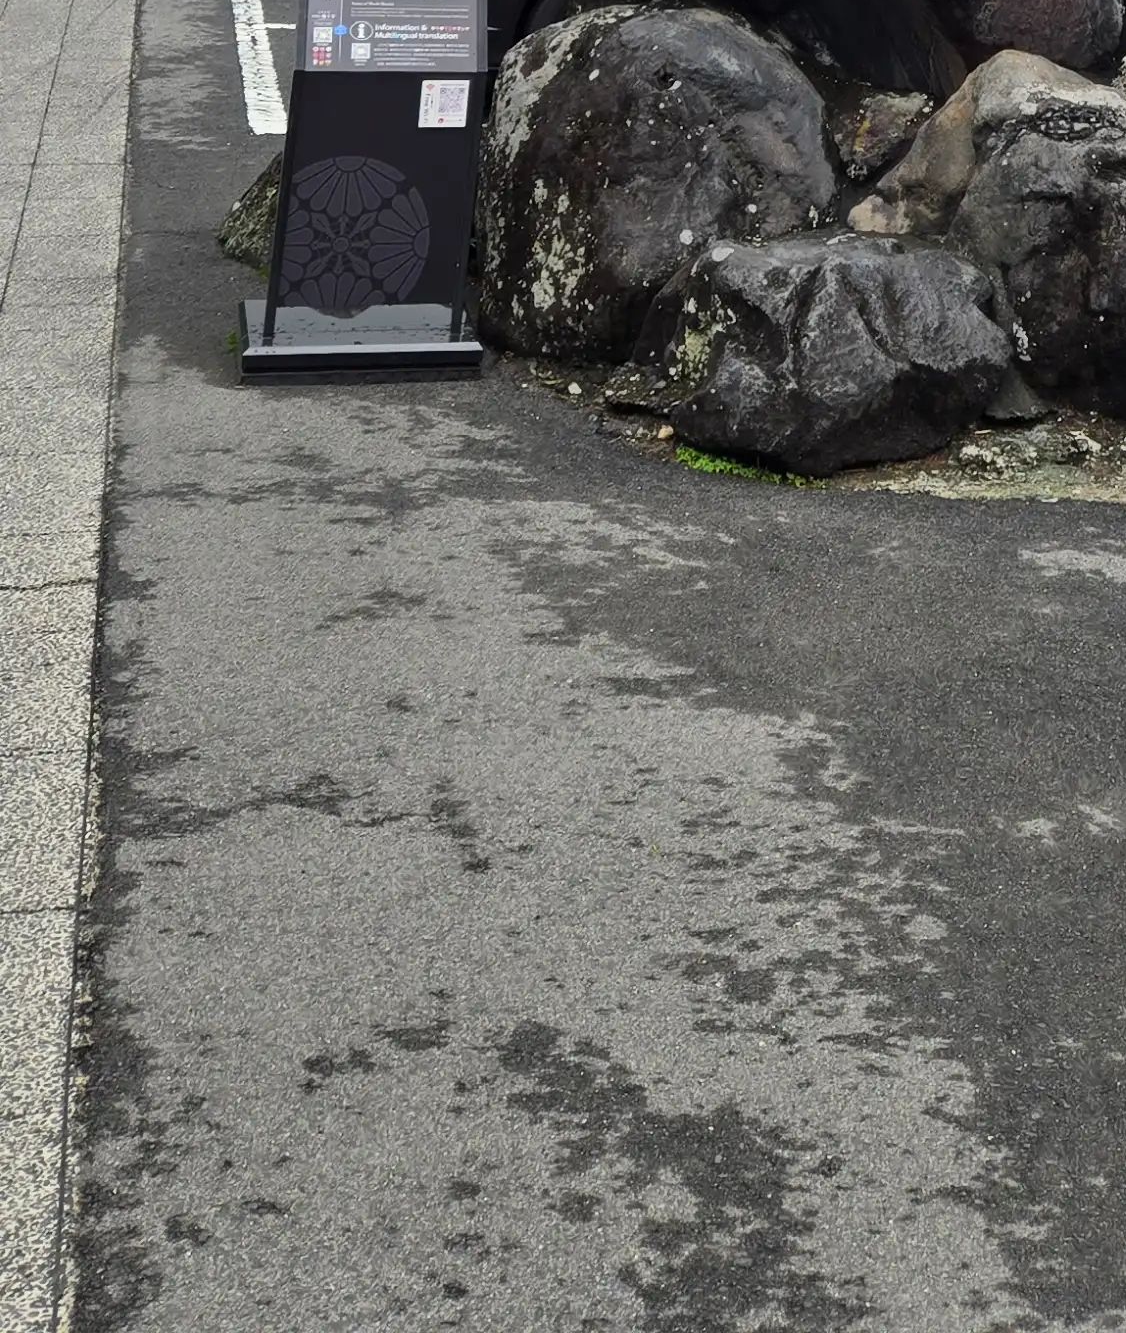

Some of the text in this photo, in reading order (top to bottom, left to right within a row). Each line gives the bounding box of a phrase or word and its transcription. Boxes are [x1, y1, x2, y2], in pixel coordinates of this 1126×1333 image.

[374, 23, 420, 32] Information
[374, 32, 459, 41] Multilingual translation
